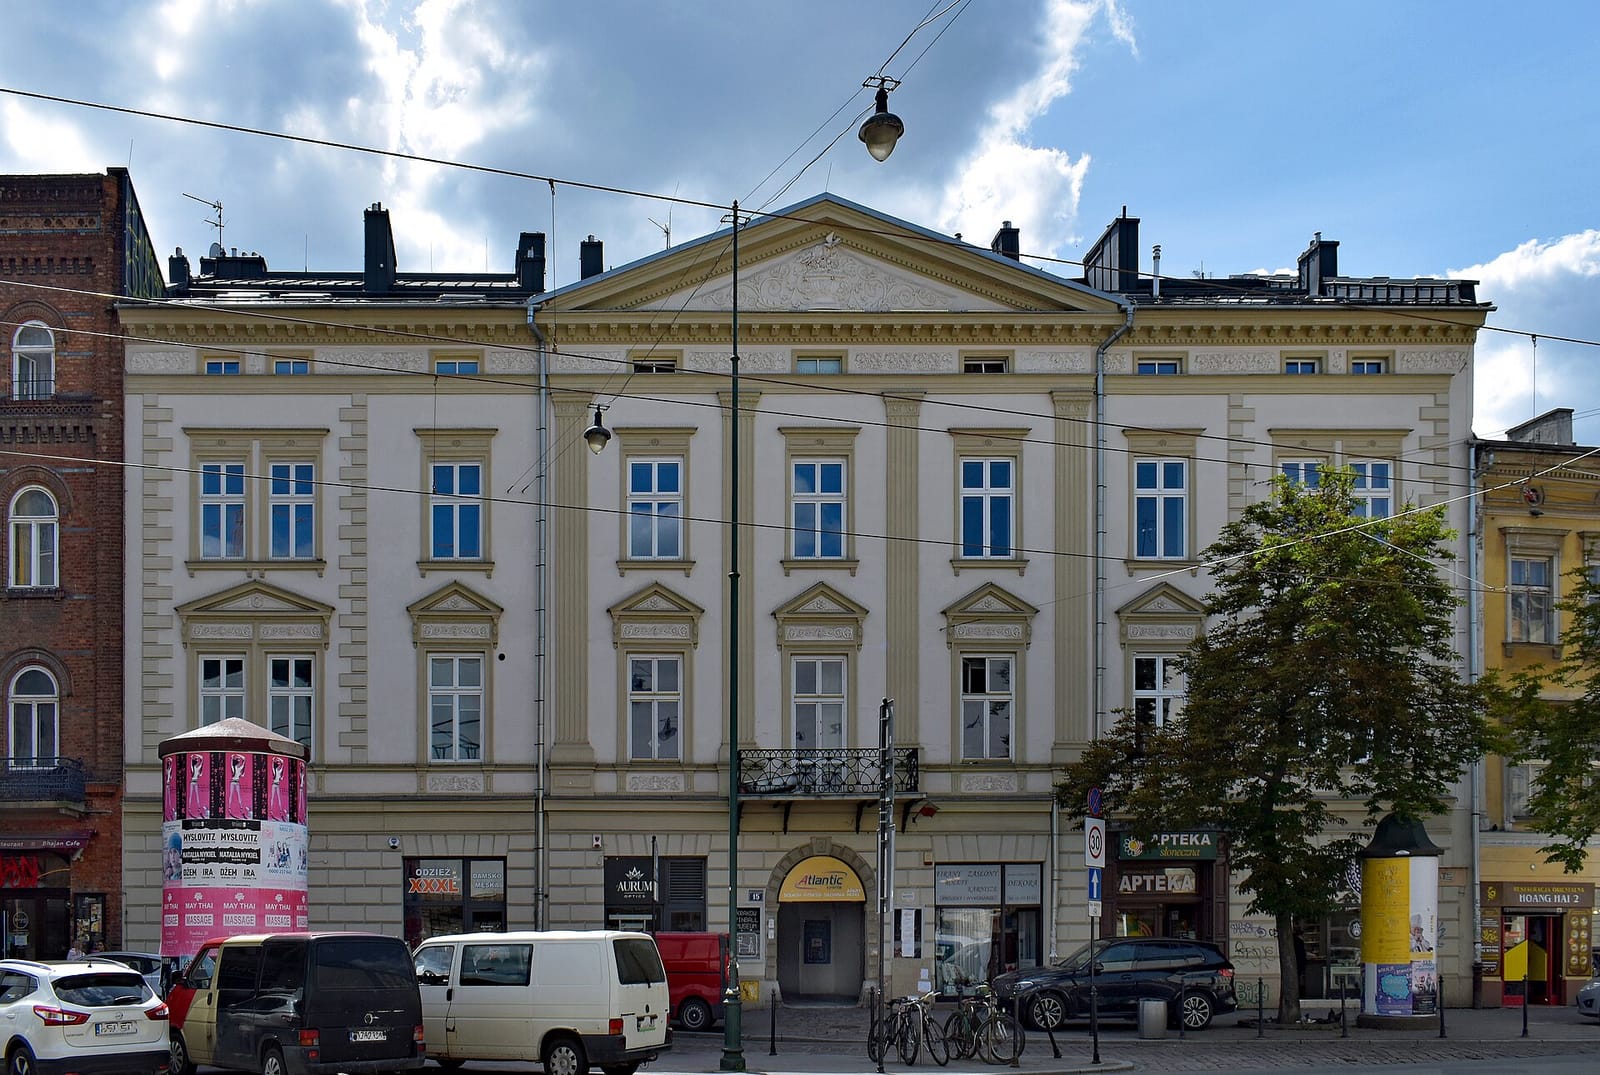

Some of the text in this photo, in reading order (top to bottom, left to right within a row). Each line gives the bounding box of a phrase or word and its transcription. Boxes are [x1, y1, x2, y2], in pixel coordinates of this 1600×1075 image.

[183, 833, 216, 841] MYSLOVITZ
[220, 833, 258, 842] MYSLOVITZ
[1091, 835, 1100, 850] 30
[183, 867, 197, 877] DŻEM
[202, 868, 214, 876] IRA
[220, 867, 237, 876] DŻEM
[243, 869, 255, 877] IRA
[415, 867, 451, 876] ODZIEŻ
[798, 874, 843, 885] Atlantic
[1119, 874, 1194, 892] APTEKA
[408, 877, 460, 894] XXXL
[617, 881, 653, 892] AURUM
[1519, 894, 1580, 903] HOANG HAI 2
[186, 915, 213, 925] MASSAGE
[224, 915, 255, 925] MASSAGE
[266, 916, 290, 925] MASSAGE
